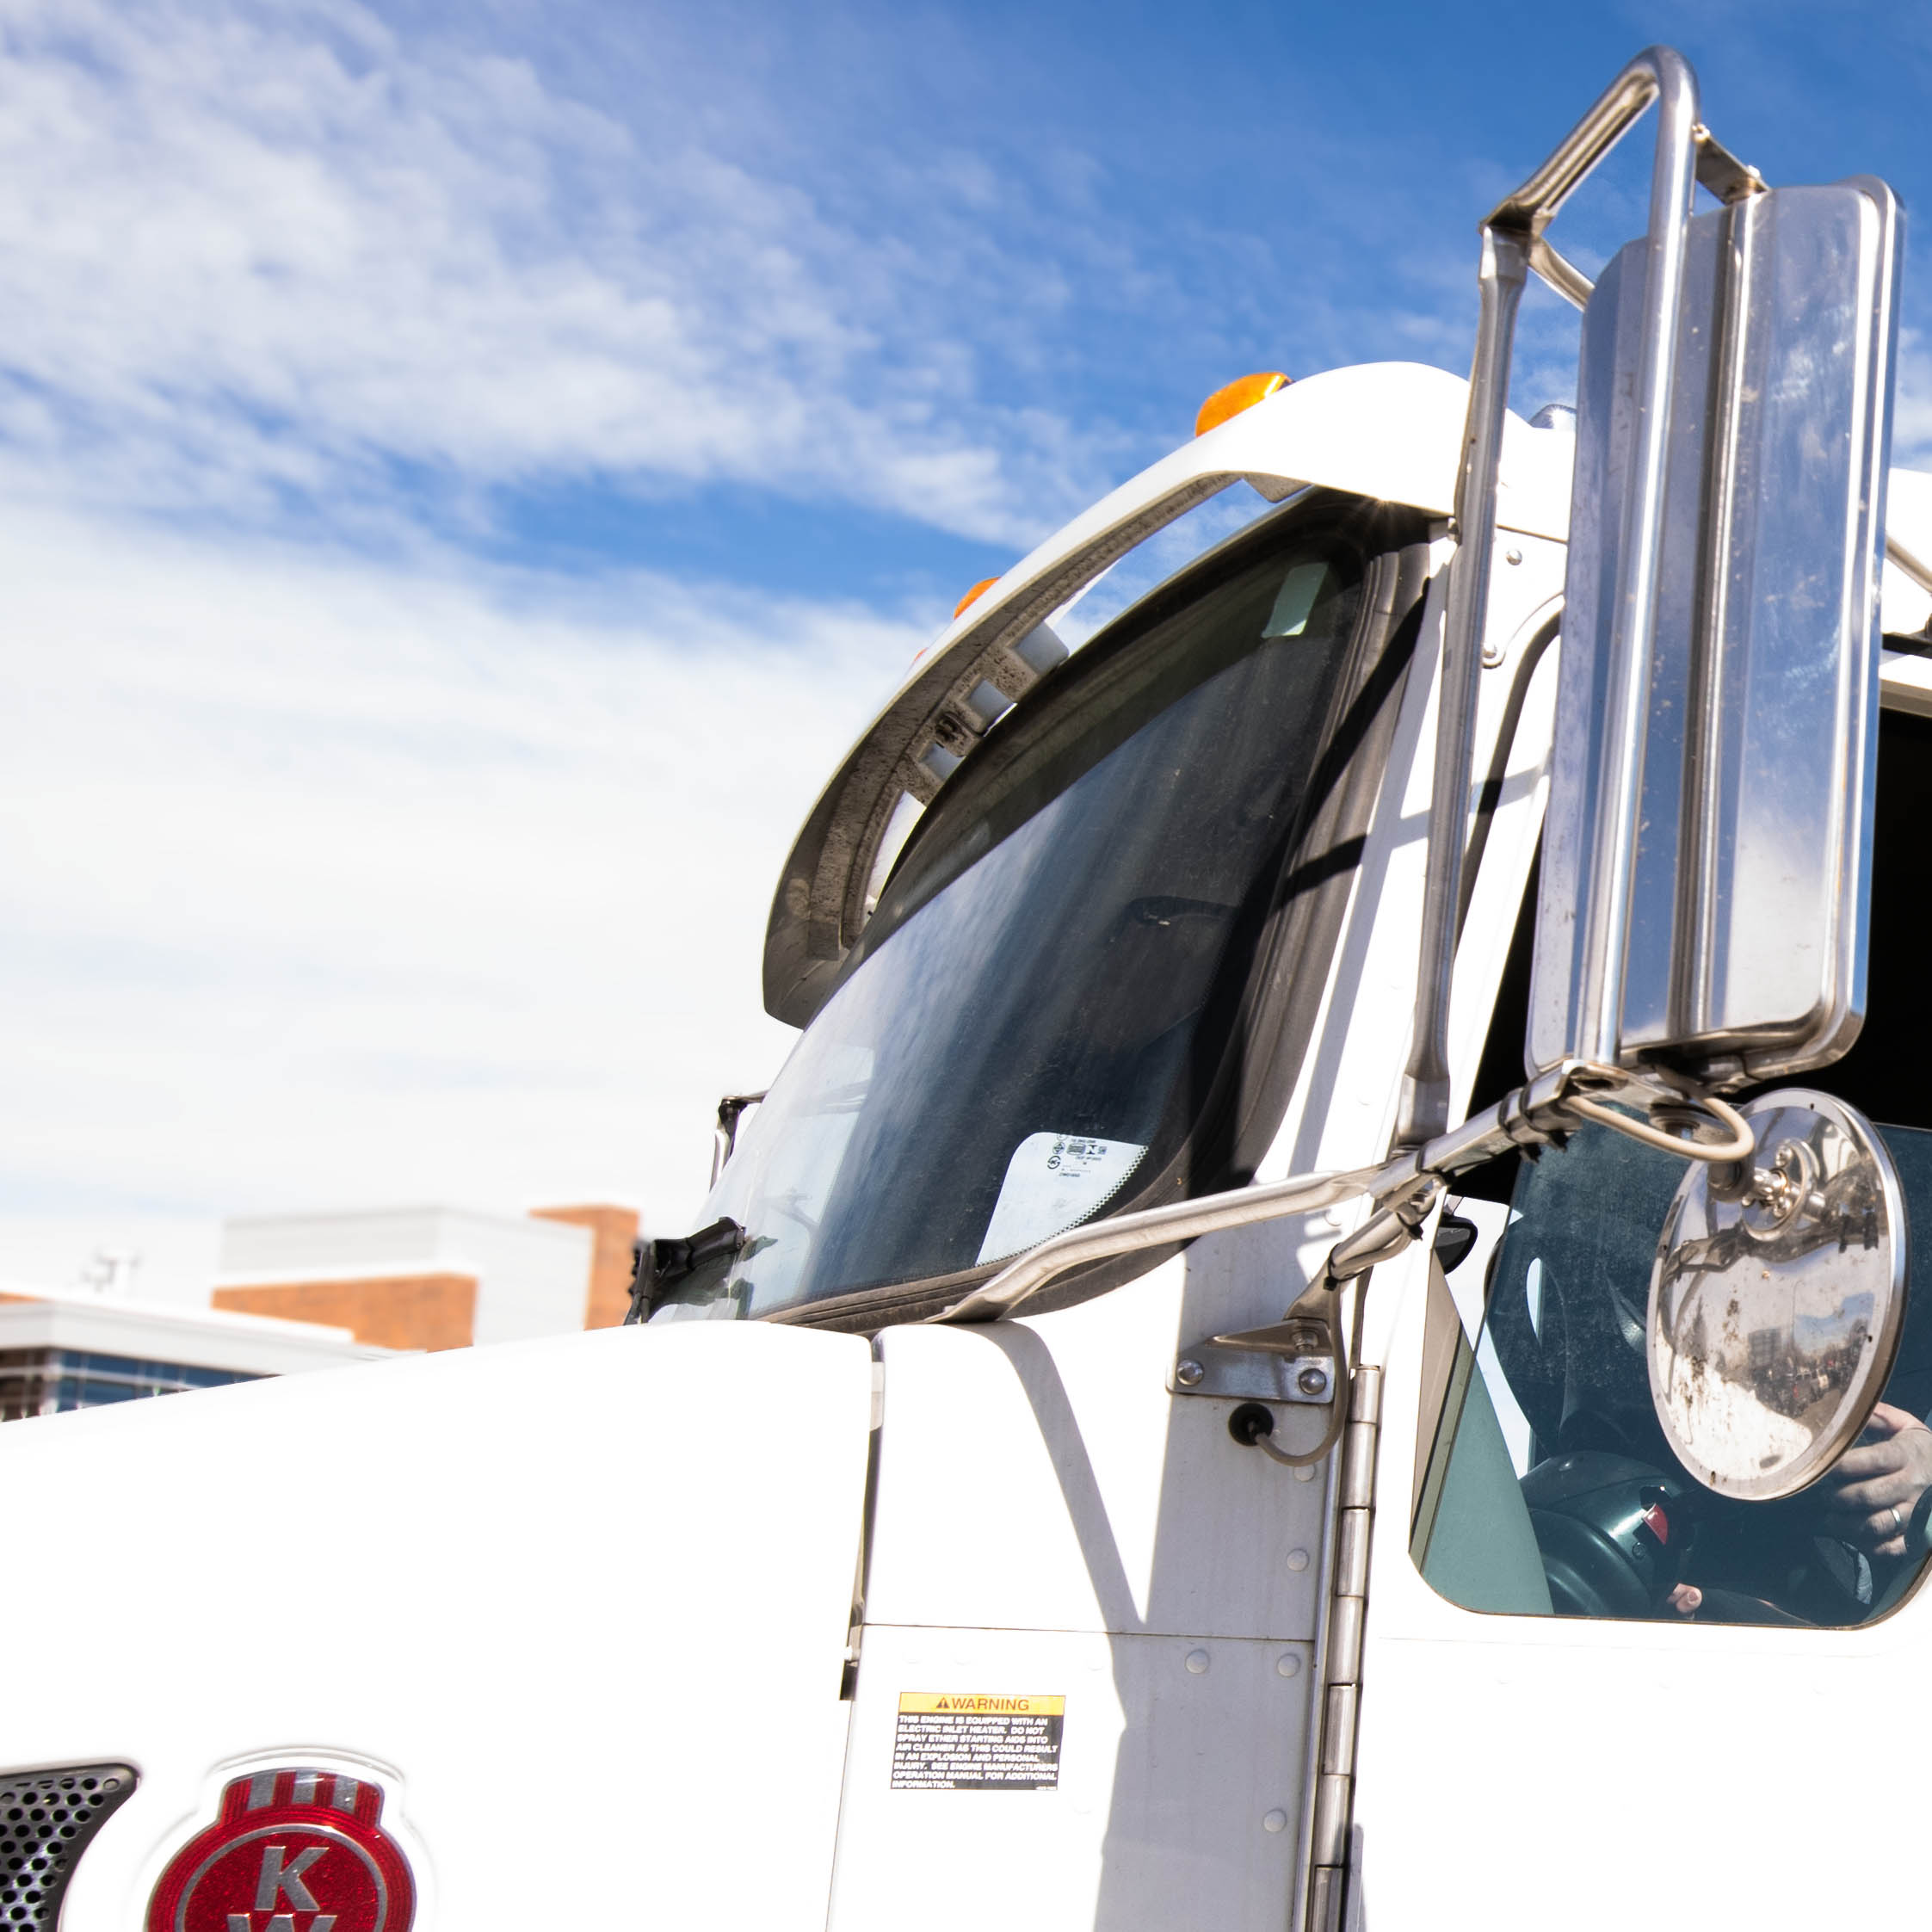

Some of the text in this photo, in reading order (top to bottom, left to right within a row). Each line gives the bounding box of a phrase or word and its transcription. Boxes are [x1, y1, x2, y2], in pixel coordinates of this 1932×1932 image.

[953, 1698, 1029, 1711] WARNING
[920, 1715, 954, 1724] ENGINE
[966, 1716, 1009, 1725] EQUIPPED
[898, 1724, 941, 1732] ELECTRIC
[942, 1725, 969, 1733] INLET
[969, 1725, 1007, 1734] HEATER.
[929, 1734, 959, 1743] ETHER
[959, 1735, 1003, 1744] STARTING
[1027, 1736, 1048, 1744] INTO
[895, 1743, 912, 1751] AIR
[956, 1744, 970, 1752] AS
[970, 1744, 991, 1752] THIS
[894, 1752, 1040, 1762] IN AN EXPLOSION AND PERSONAL
[931, 1762, 948, 1770] SEE
[949, 1762, 982, 1771] ENGINE
[946, 1771, 984, 1780] MANUAL
[1005, 1772, 1057, 1781] ADDITIONAL
[892, 1780, 956, 1788] INFORMATION.
[255, 1846, 330, 1911] K
